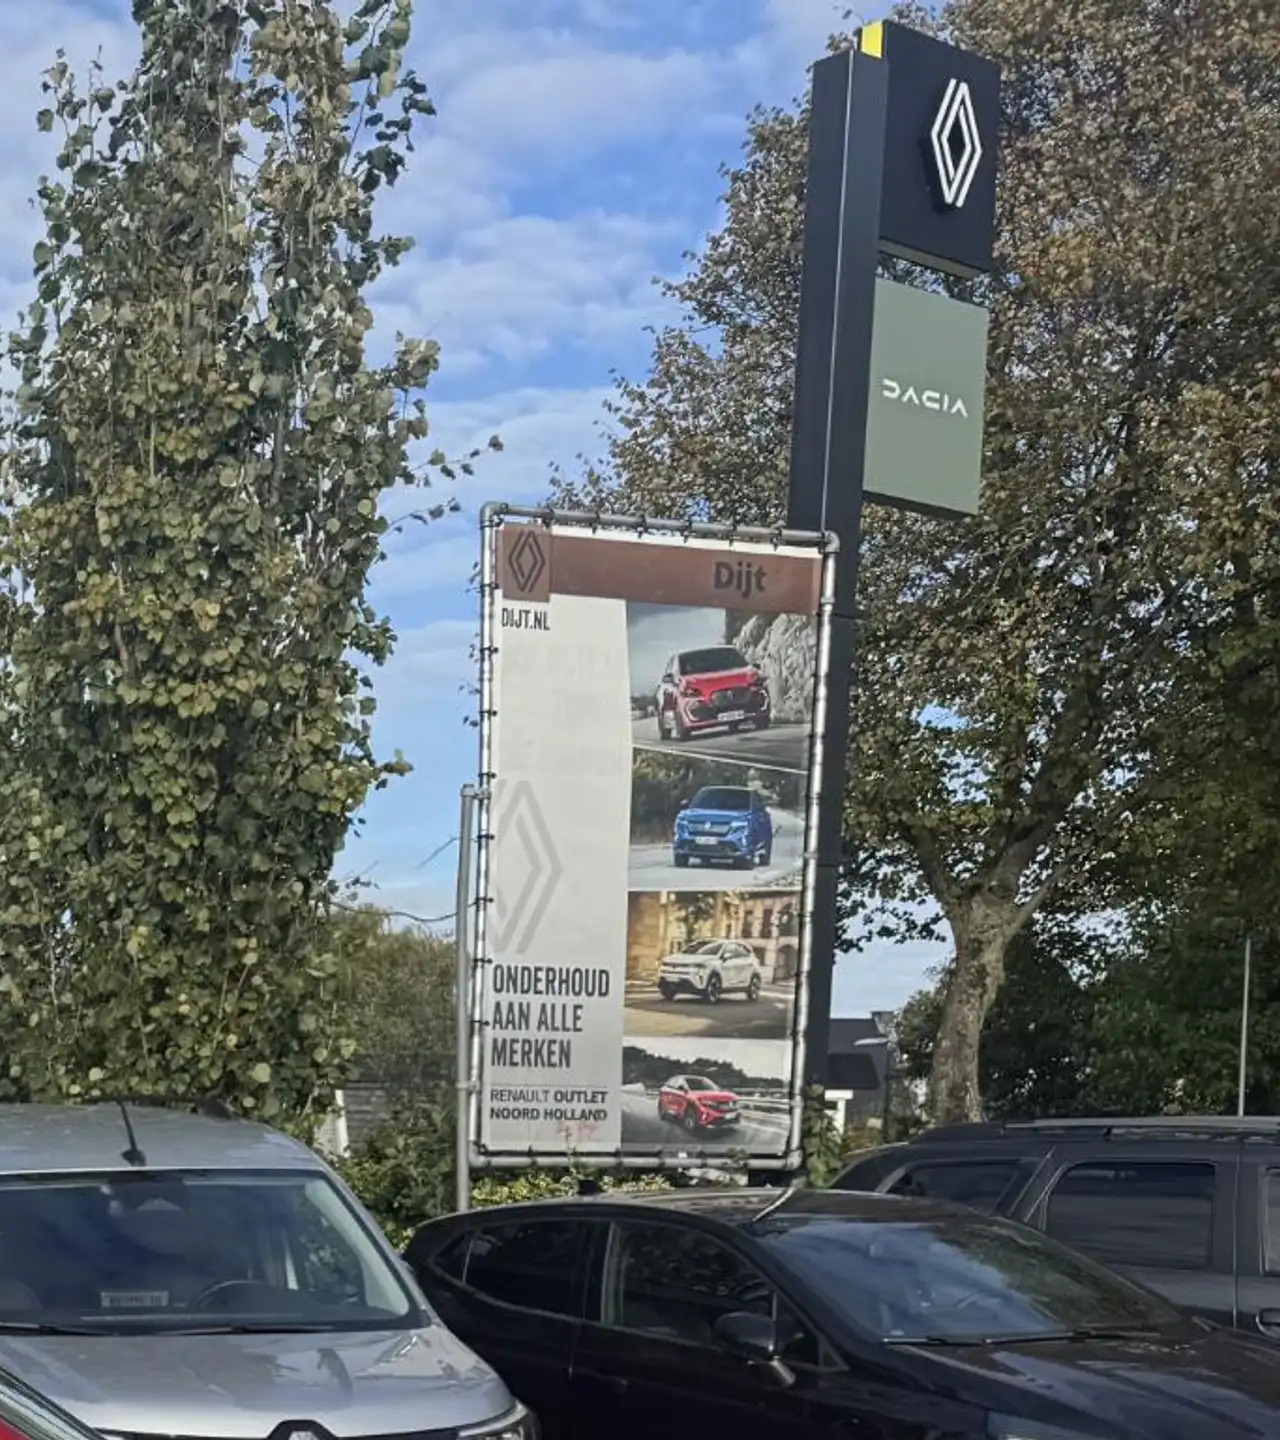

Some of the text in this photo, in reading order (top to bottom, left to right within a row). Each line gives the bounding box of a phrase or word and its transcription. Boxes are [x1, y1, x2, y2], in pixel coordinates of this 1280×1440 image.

[882, 379, 968, 417] DACIA
[714, 561, 767, 598] Dijt
[501, 607, 550, 631] DIJT.NL
[493, 964, 610, 997] ONDERHOUD
[492, 1001, 584, 1032] AAN ALLE
[491, 1038, 571, 1068] MERKEN
[490, 1088, 608, 1104] RENAULT OUTLET
[490, 1107, 608, 1121] NOORD HOLLAND
